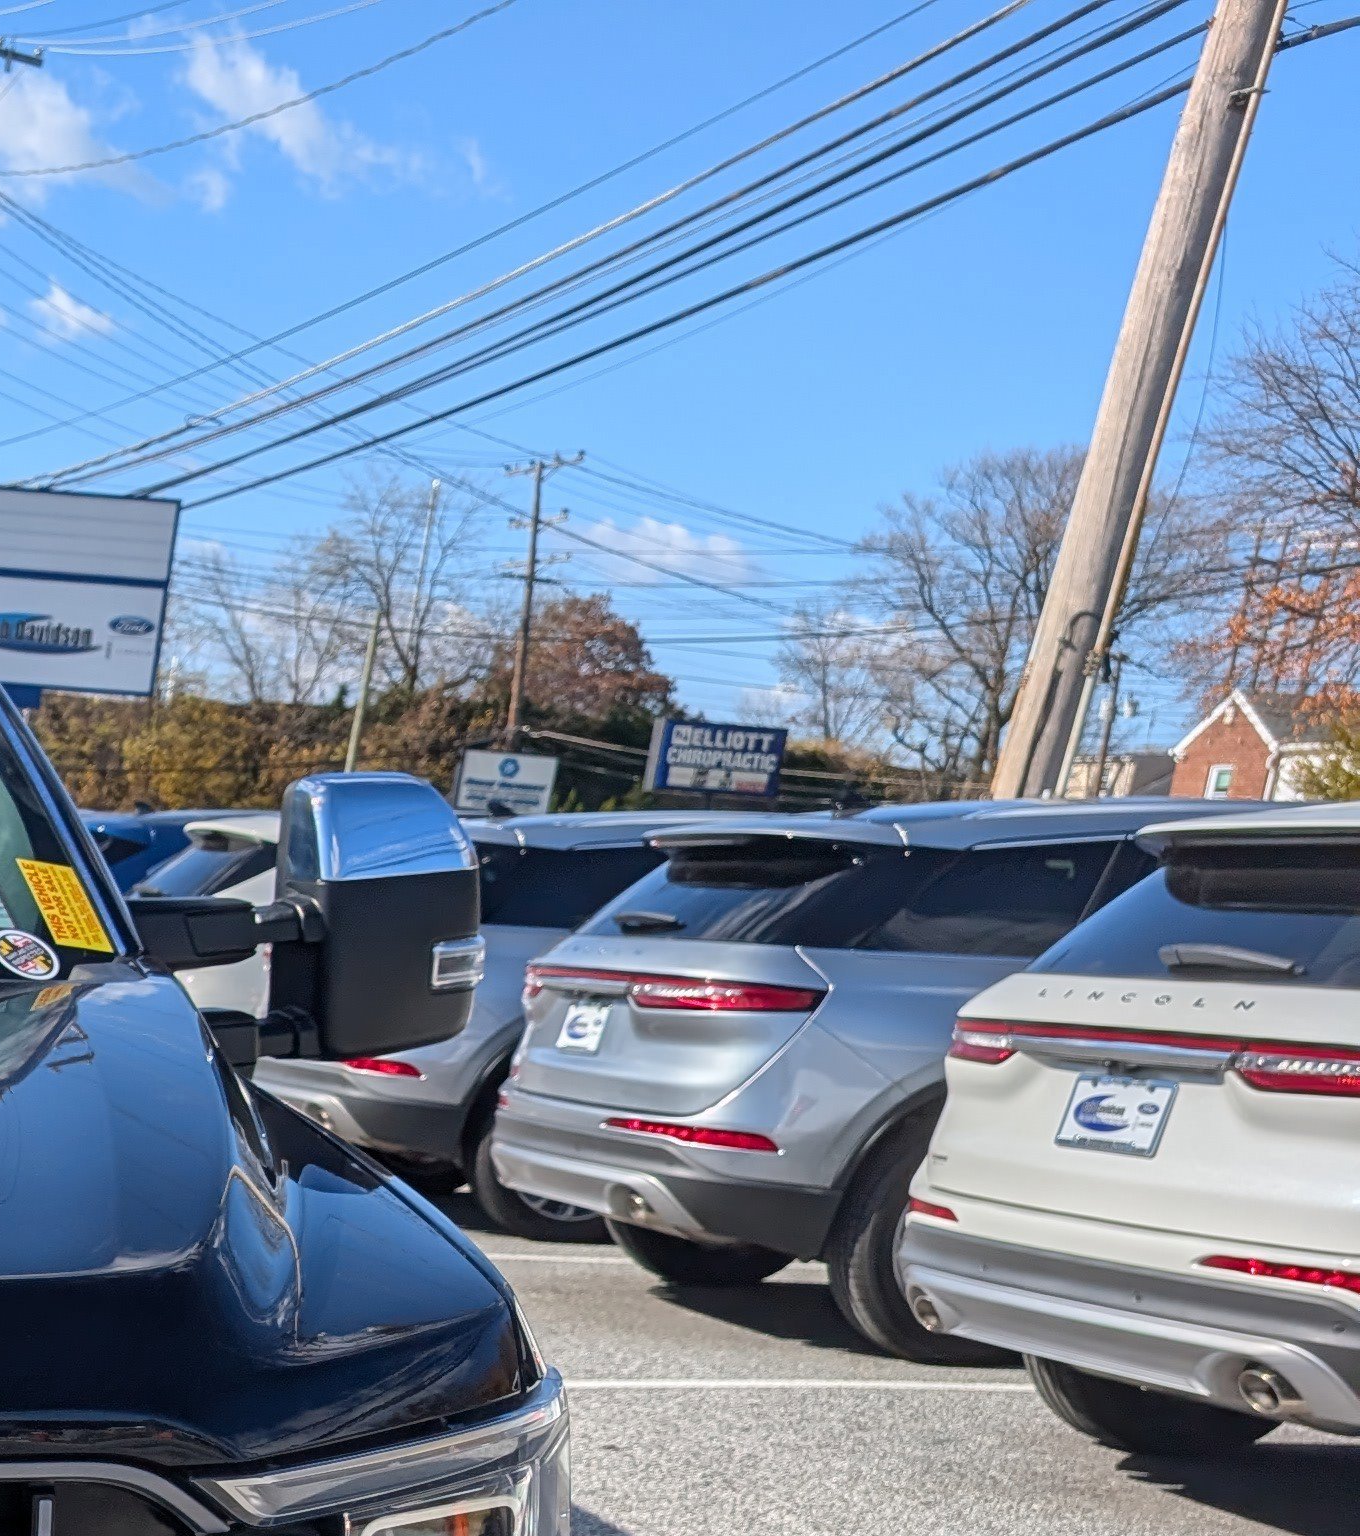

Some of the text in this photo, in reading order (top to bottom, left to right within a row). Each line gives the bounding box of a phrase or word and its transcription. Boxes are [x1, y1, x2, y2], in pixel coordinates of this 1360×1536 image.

[690, 727, 775, 753] ELLIOTT
[666, 746, 777, 773] CHIROPRACTIC
[21, 862, 55, 912] VEHICLE
[37, 867, 82, 940] NOT FOR SALE
[47, 913, 70, 940] THIS
[1038, 987, 1256, 1011] LINCOLN
